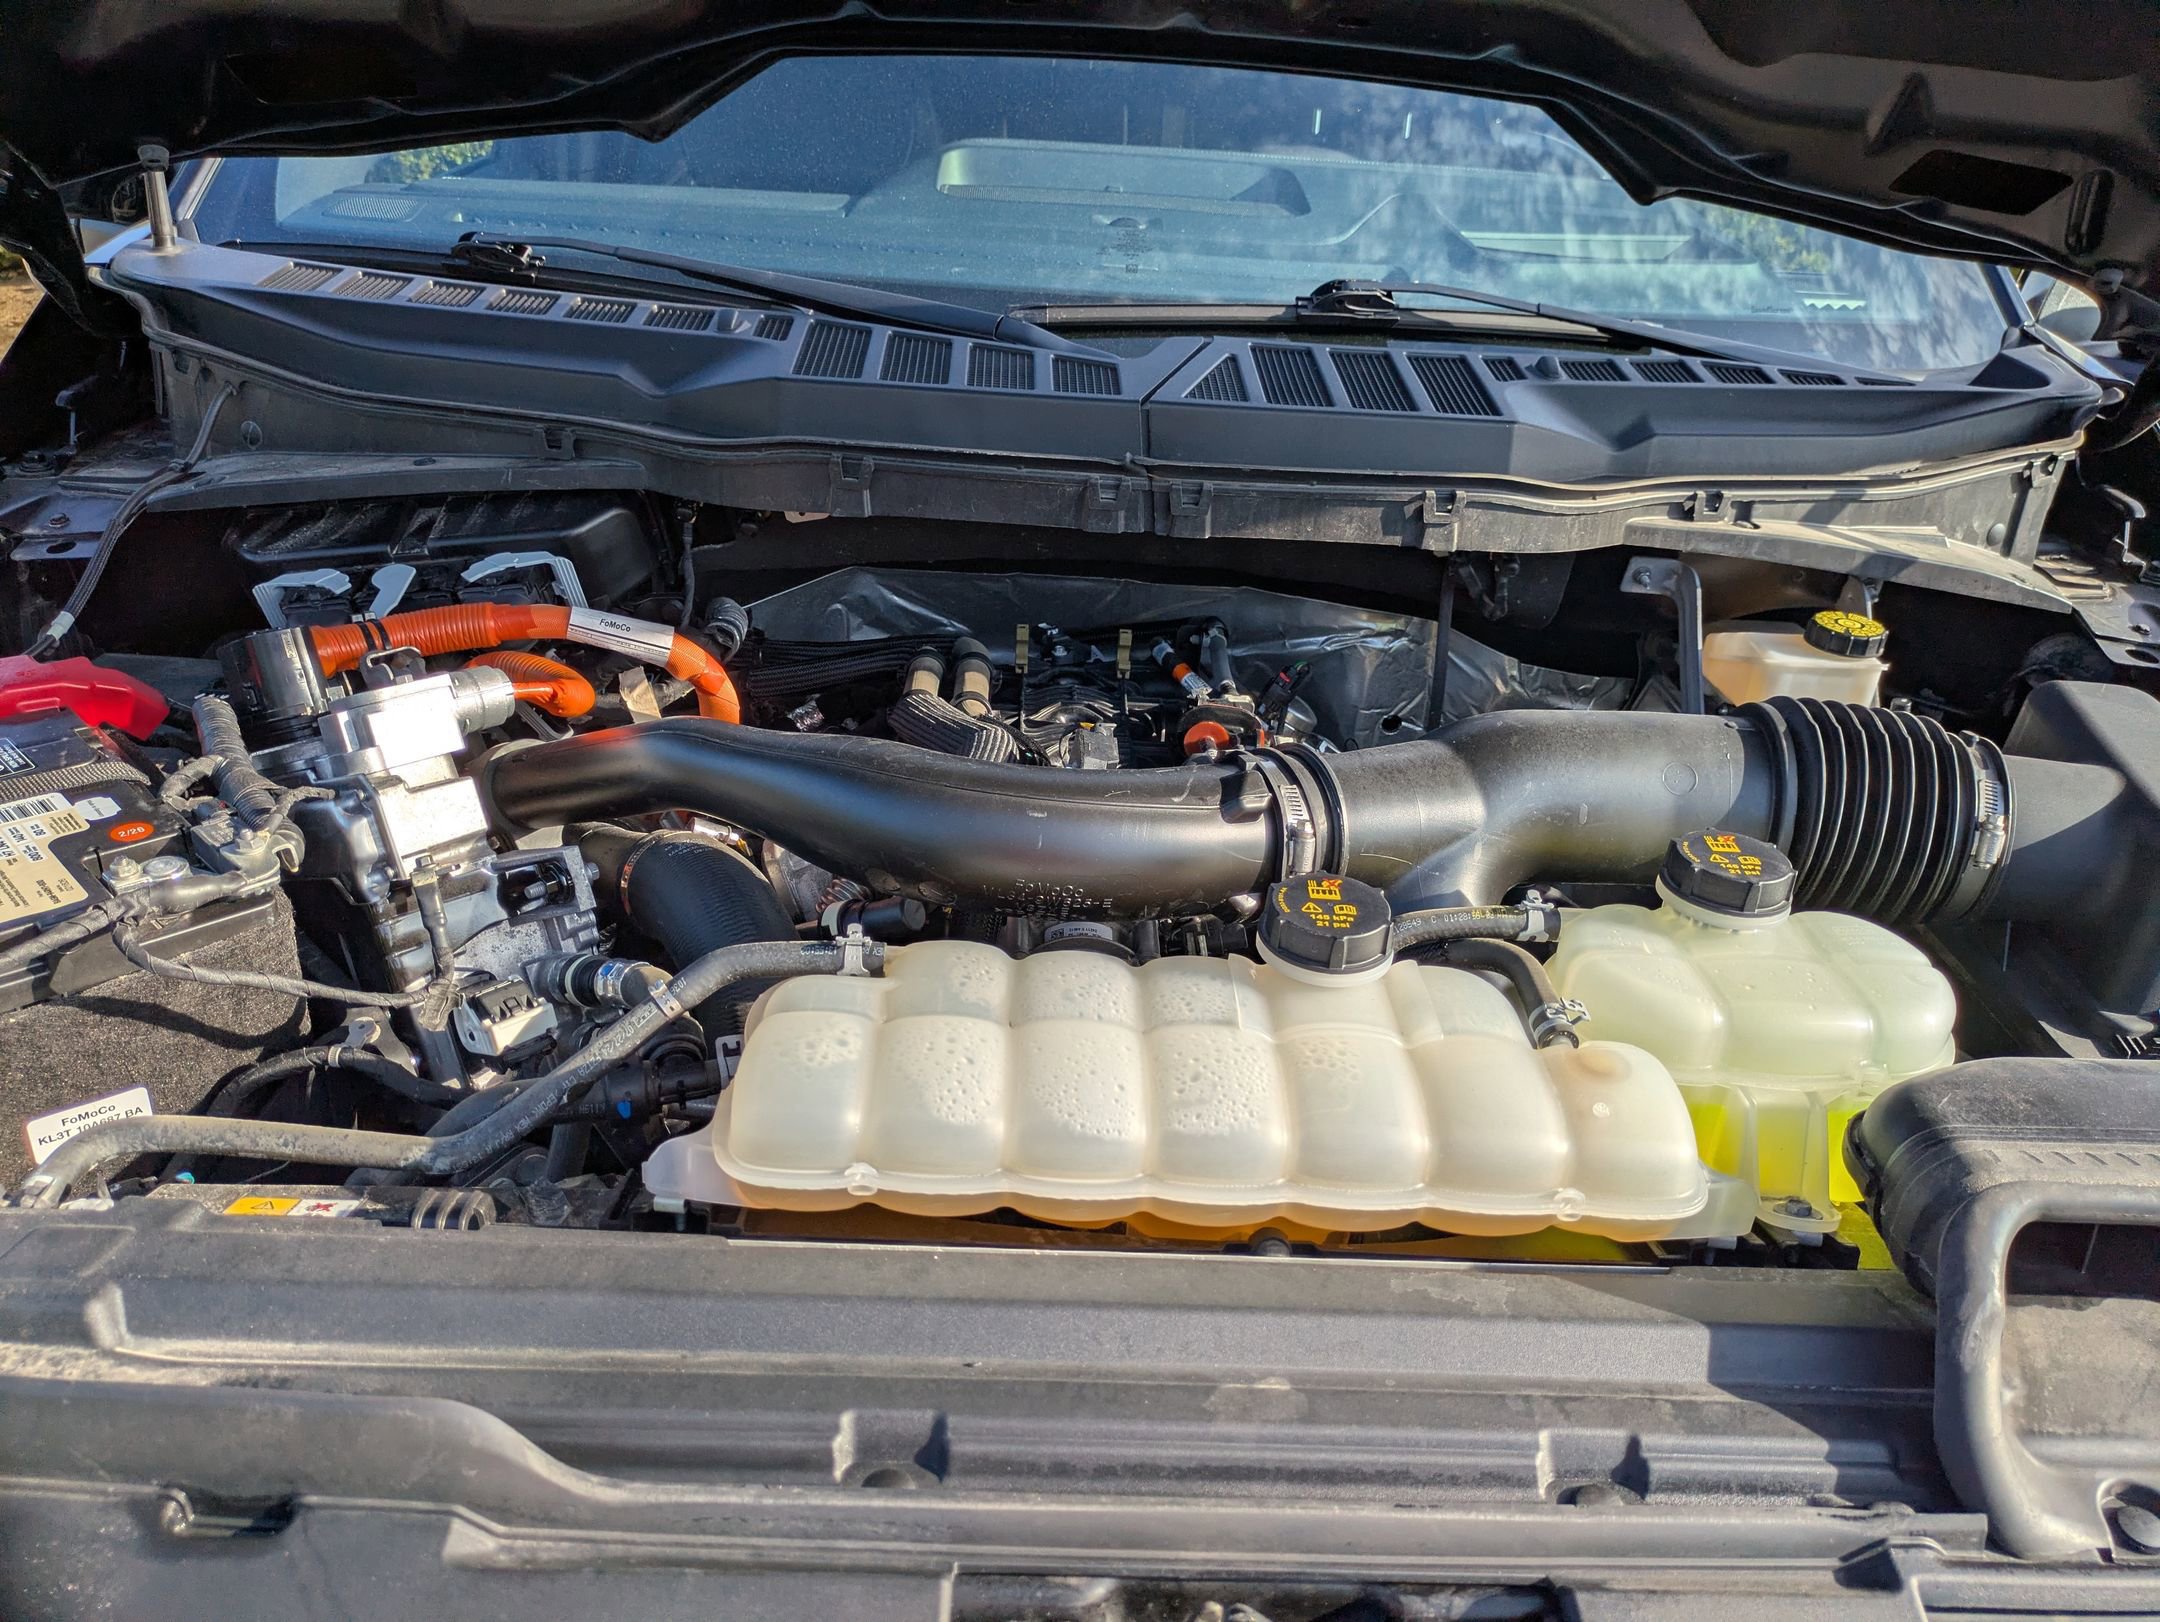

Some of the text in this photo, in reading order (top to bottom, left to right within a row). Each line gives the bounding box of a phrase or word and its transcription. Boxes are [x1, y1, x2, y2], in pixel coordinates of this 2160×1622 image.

[599, 618, 631, 633] FoMoCo
[1332, 914, 1355, 922] kPa
[60, 1104, 117, 1127] FoMoCo
[37, 1128, 73, 1146] KL3T
[124, 1106, 144, 1119] BA
